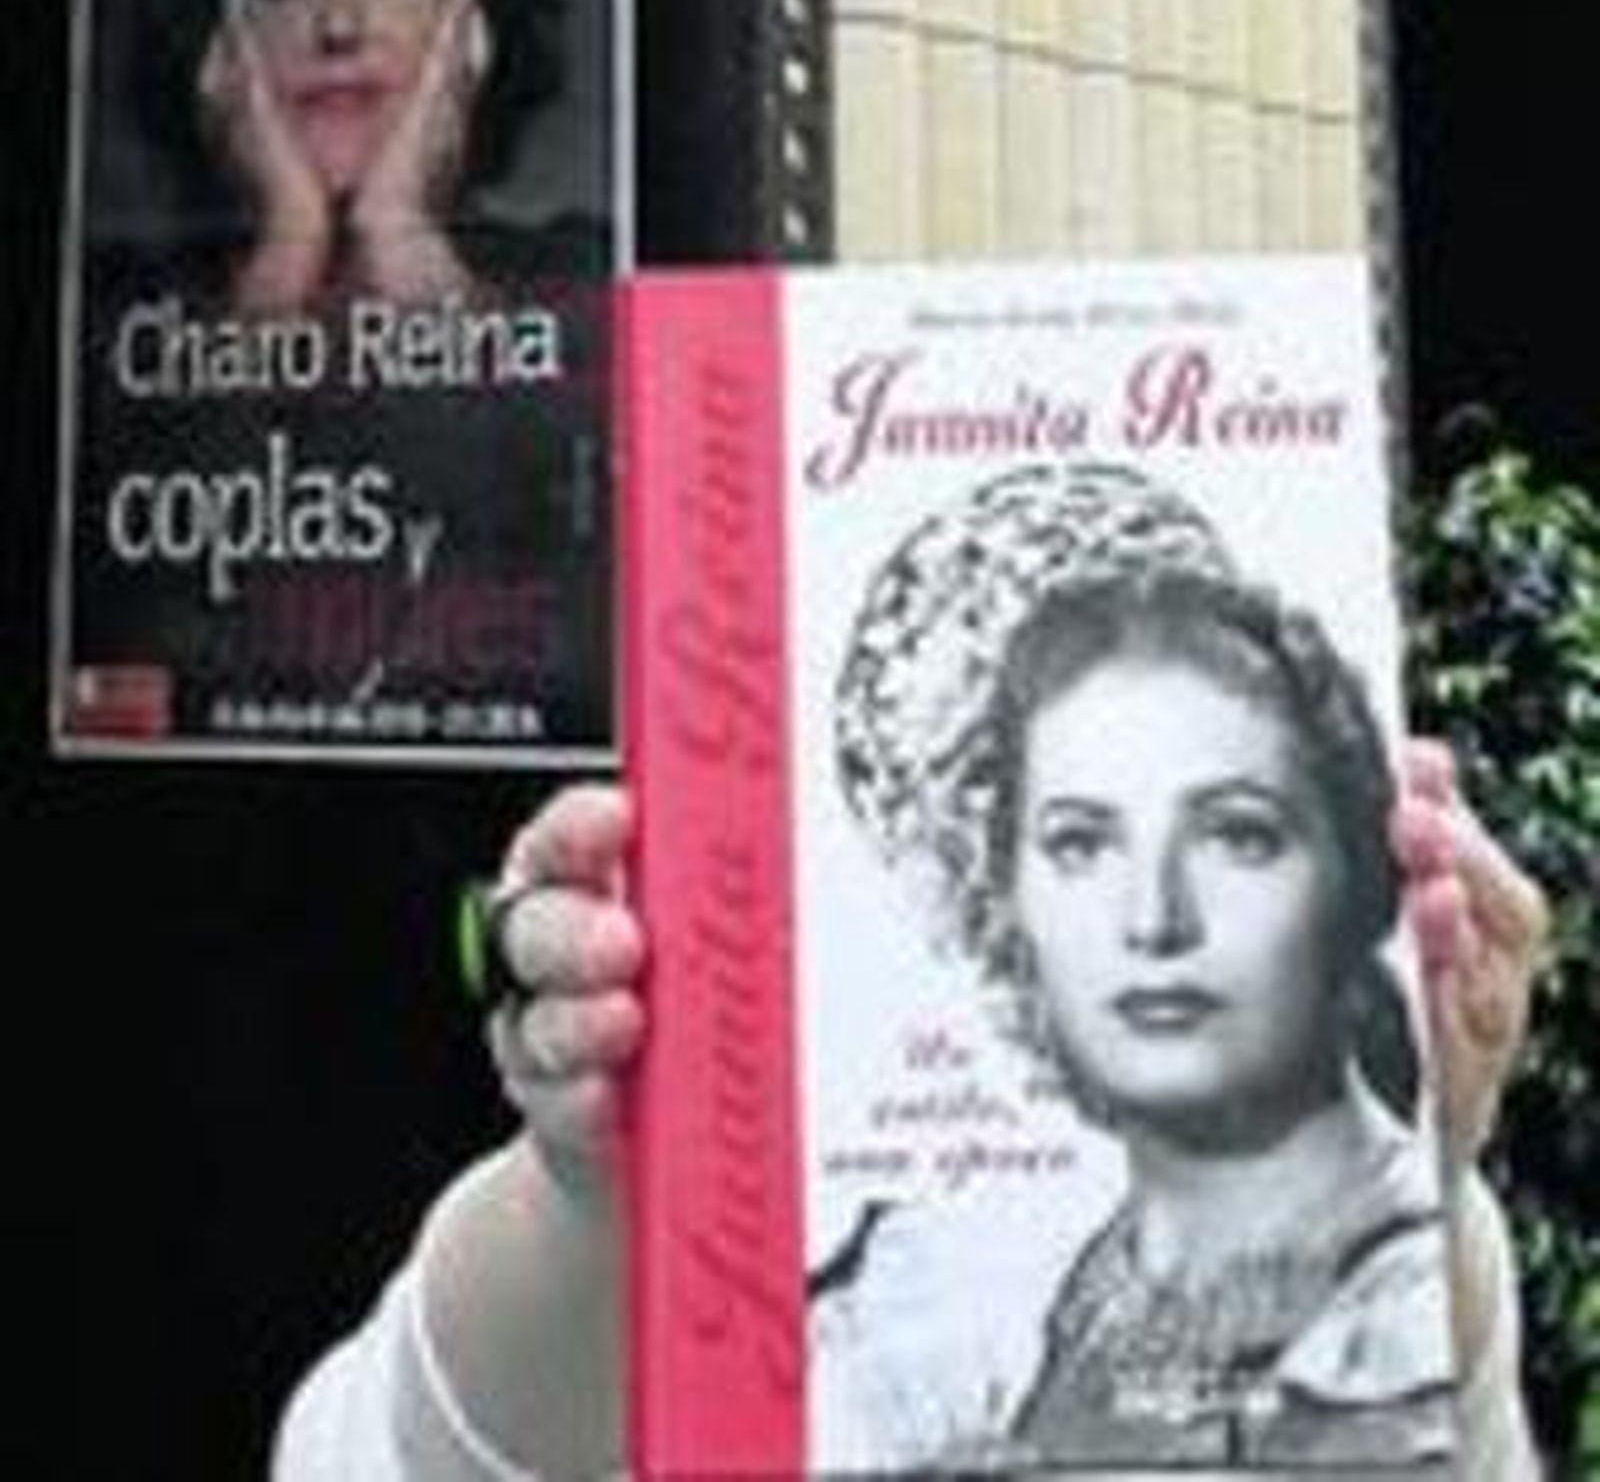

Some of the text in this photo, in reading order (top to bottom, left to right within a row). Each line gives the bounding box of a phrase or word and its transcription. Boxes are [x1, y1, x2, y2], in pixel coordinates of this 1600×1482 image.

[114, 292, 563, 397] Charo Reina
[804, 342, 1345, 490] Juanita Reina
[107, 432, 443, 602] coplas y
[657, 361, 802, 1405] Juanita Reina
